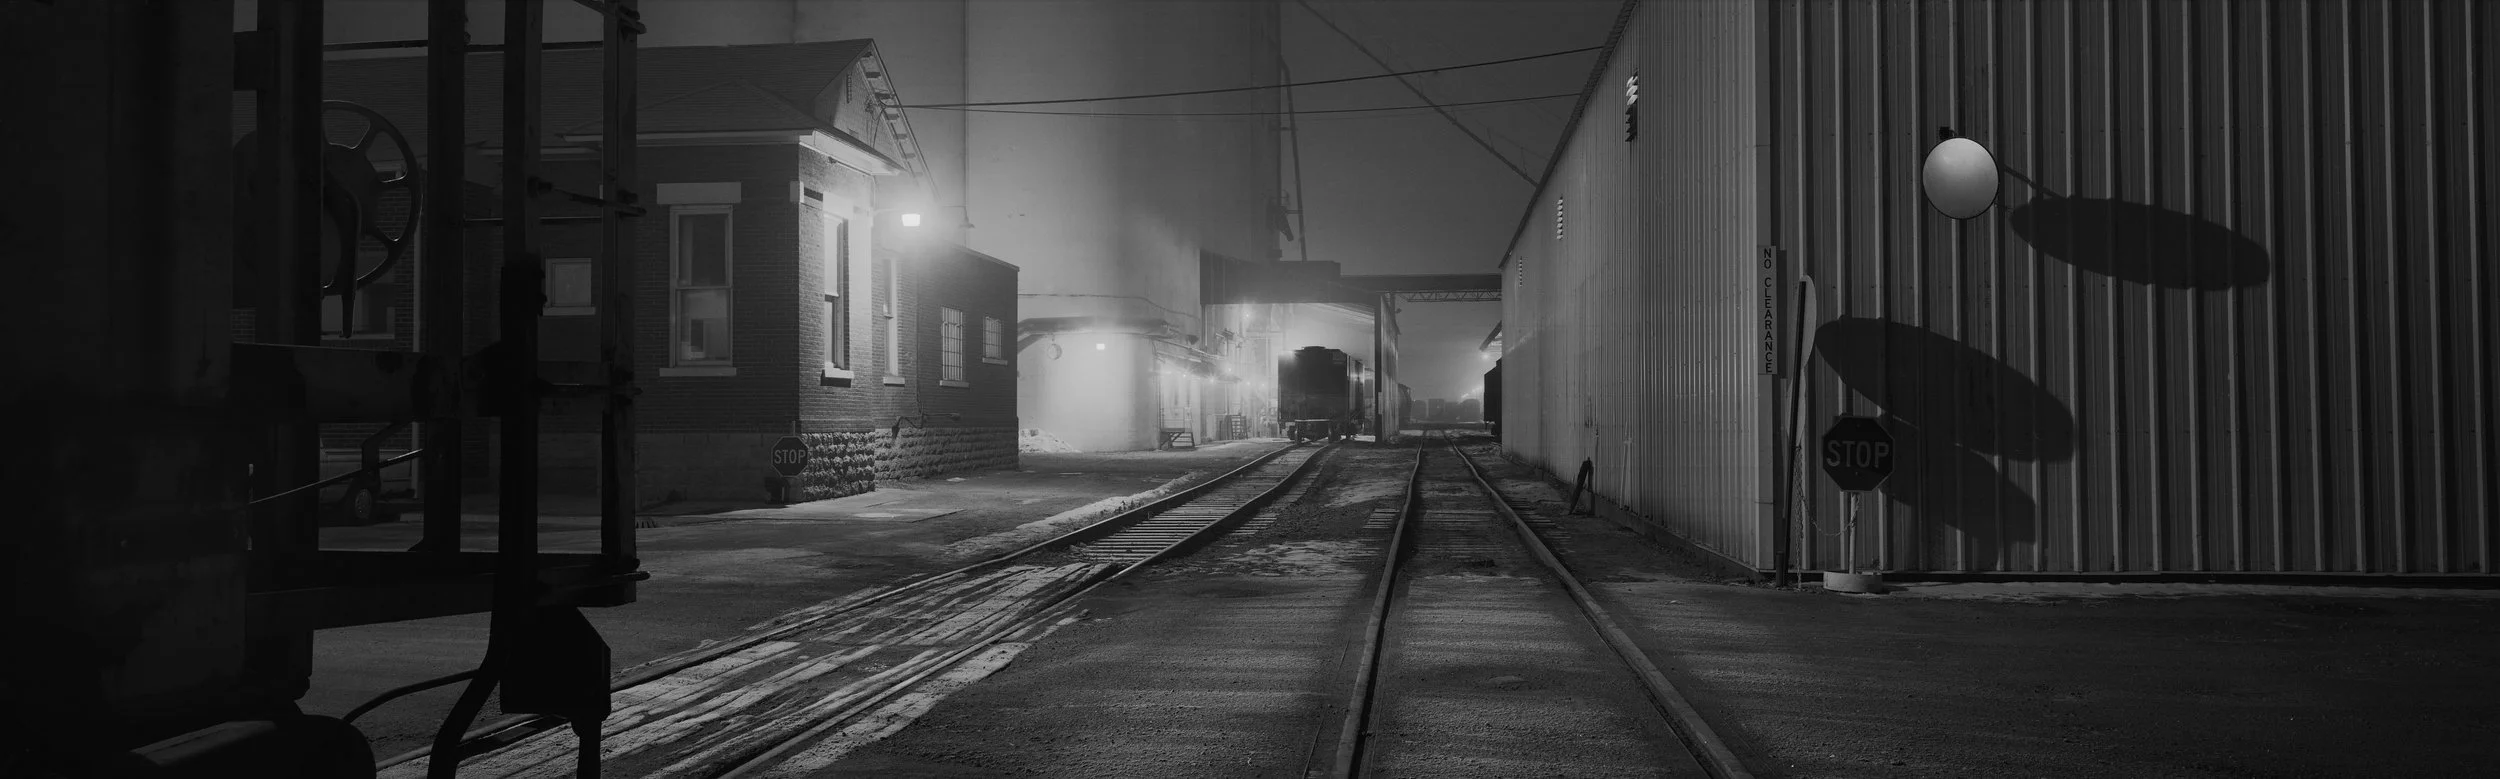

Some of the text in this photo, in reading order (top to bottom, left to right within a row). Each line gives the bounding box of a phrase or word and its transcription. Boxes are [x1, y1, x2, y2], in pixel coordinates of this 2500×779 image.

[1763, 247, 1773, 373] NO CLEARANCE
[774, 449, 806, 464] STOP
[1826, 440, 1889, 468] STOP
